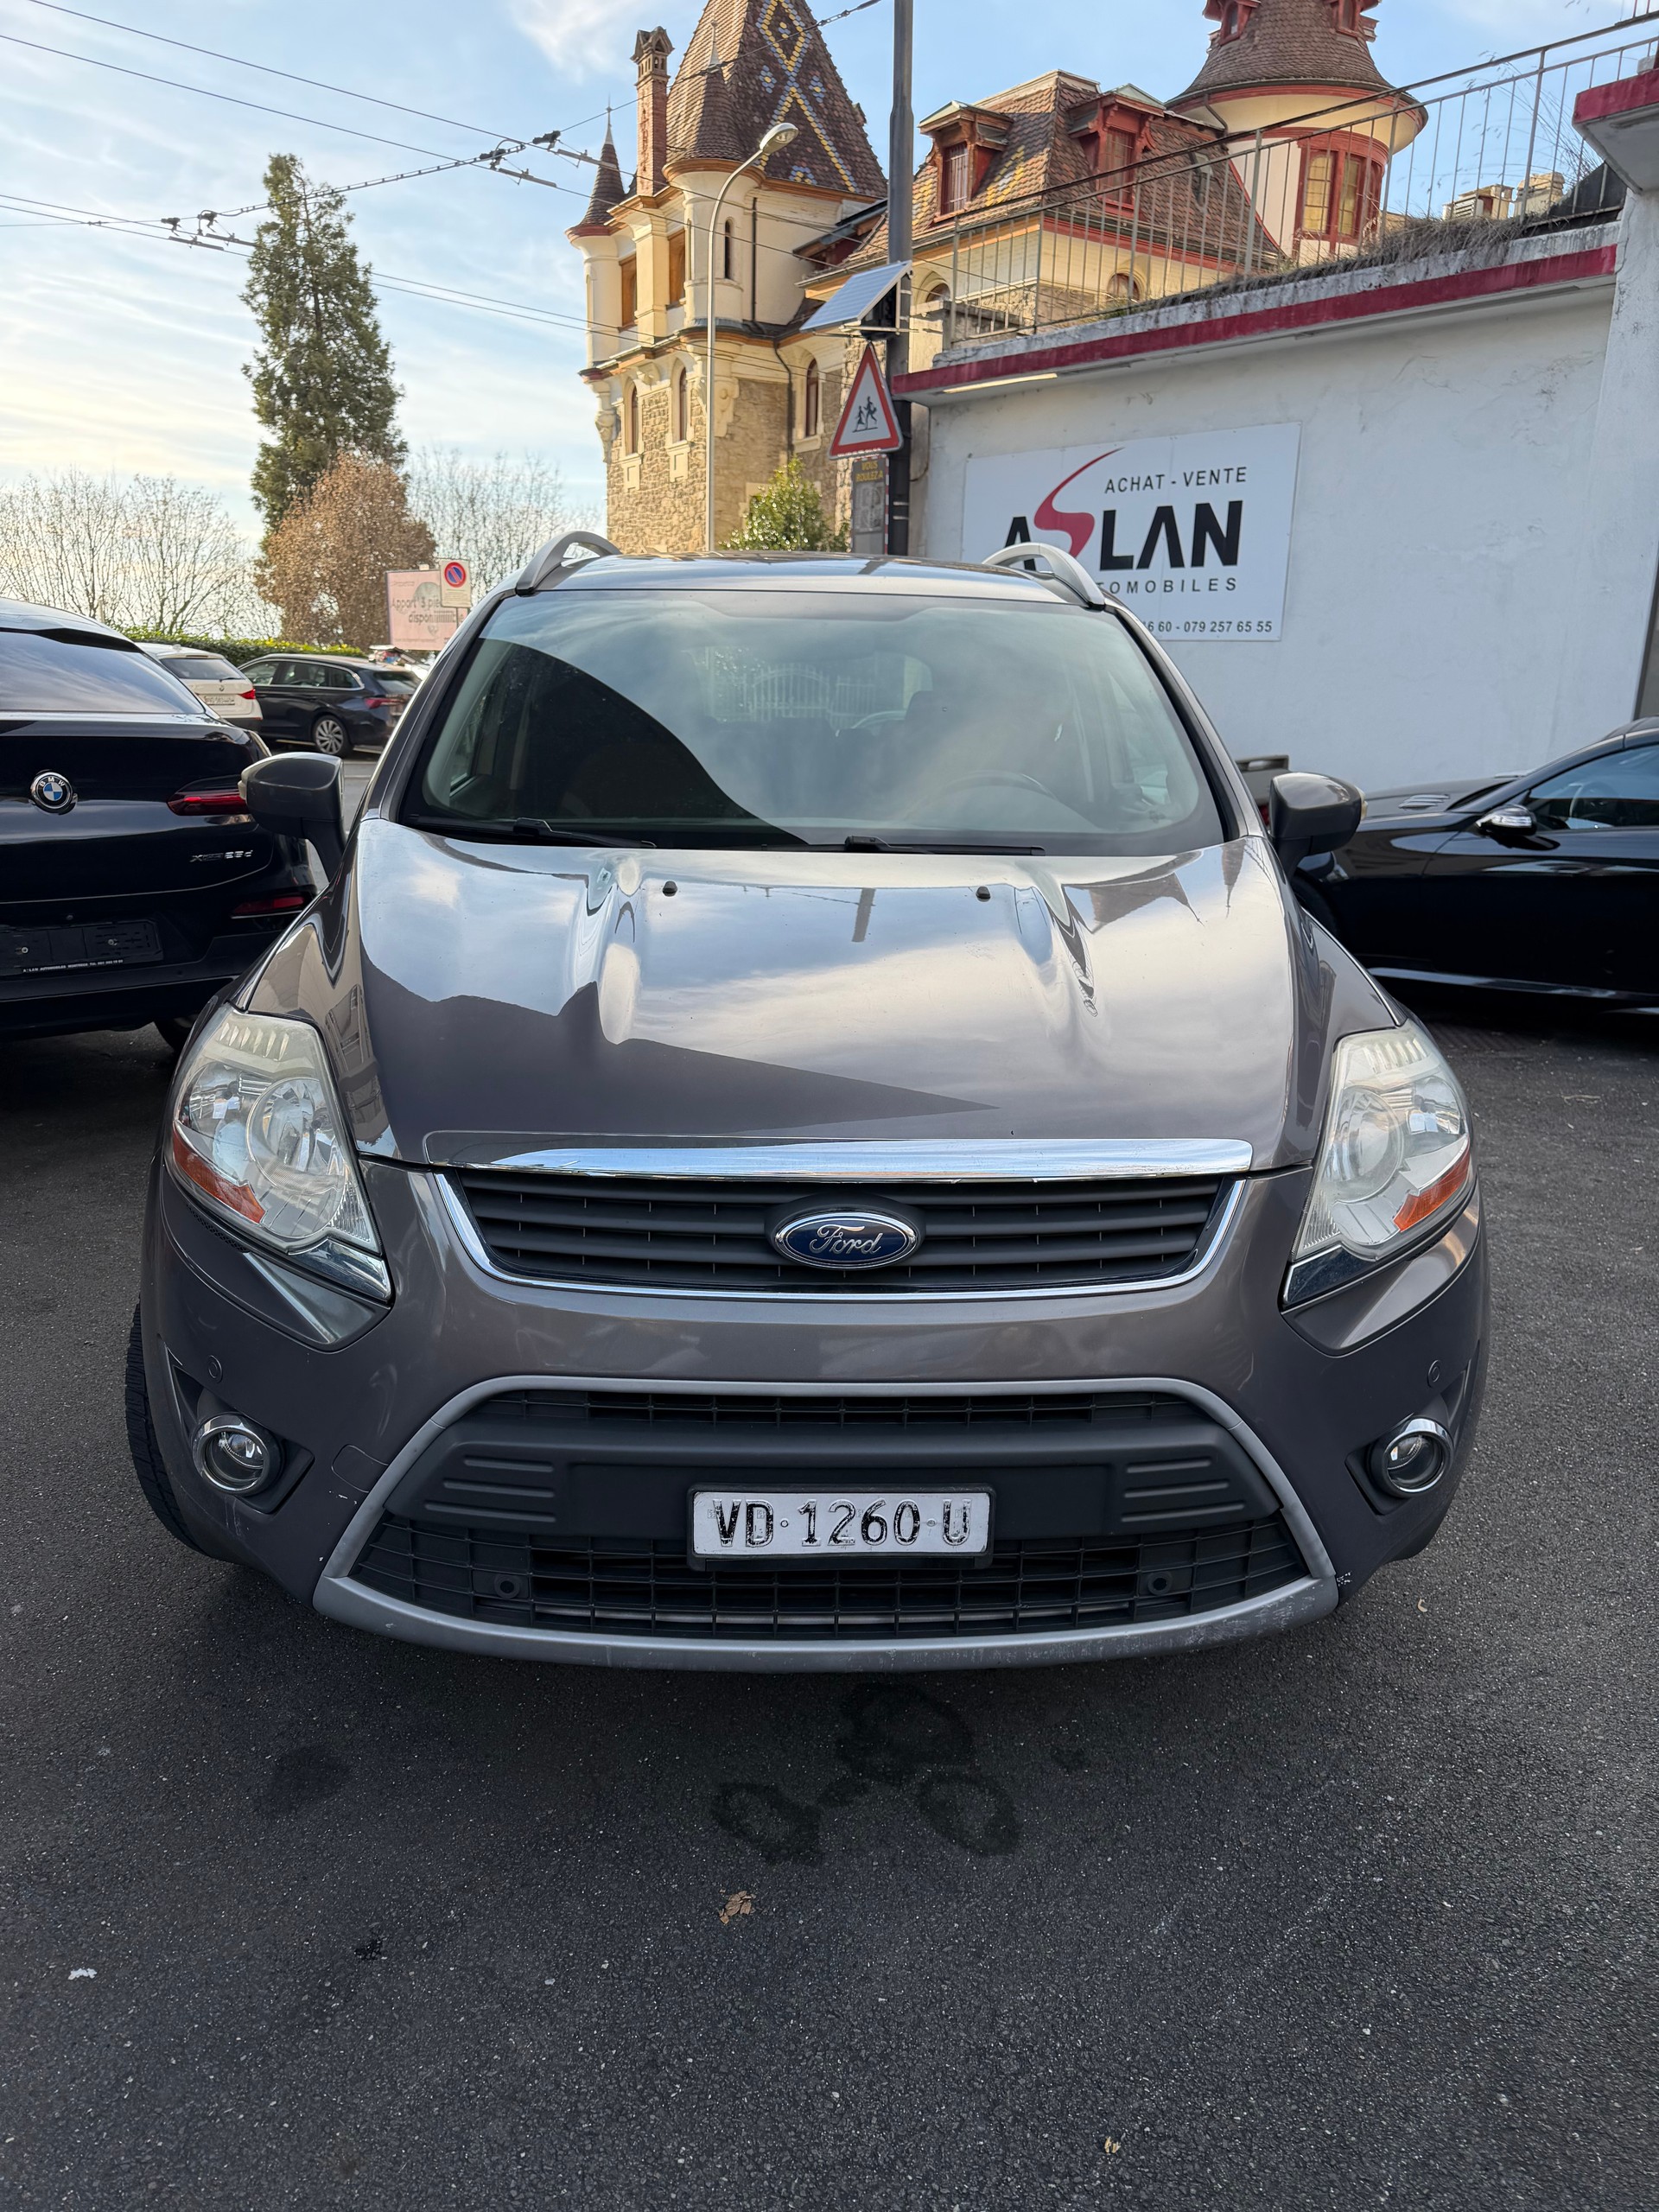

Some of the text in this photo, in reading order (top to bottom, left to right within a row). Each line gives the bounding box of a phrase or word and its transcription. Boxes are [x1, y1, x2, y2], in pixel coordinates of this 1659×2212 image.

[1104, 474, 1165, 493] ACHAT
[1183, 467, 1247, 487] VENTE
[1158, 620, 1173, 632] 60
[1184, 620, 1206, 632] 079
[1210, 620, 1233, 632] 257
[1236, 620, 1252, 632] 65
[1255, 620, 1273, 632] 55
[39, 777, 66, 787] BMW
[809, 1224, 884, 1255] Ford
[712, 1497, 972, 1548] VD 1260 U
